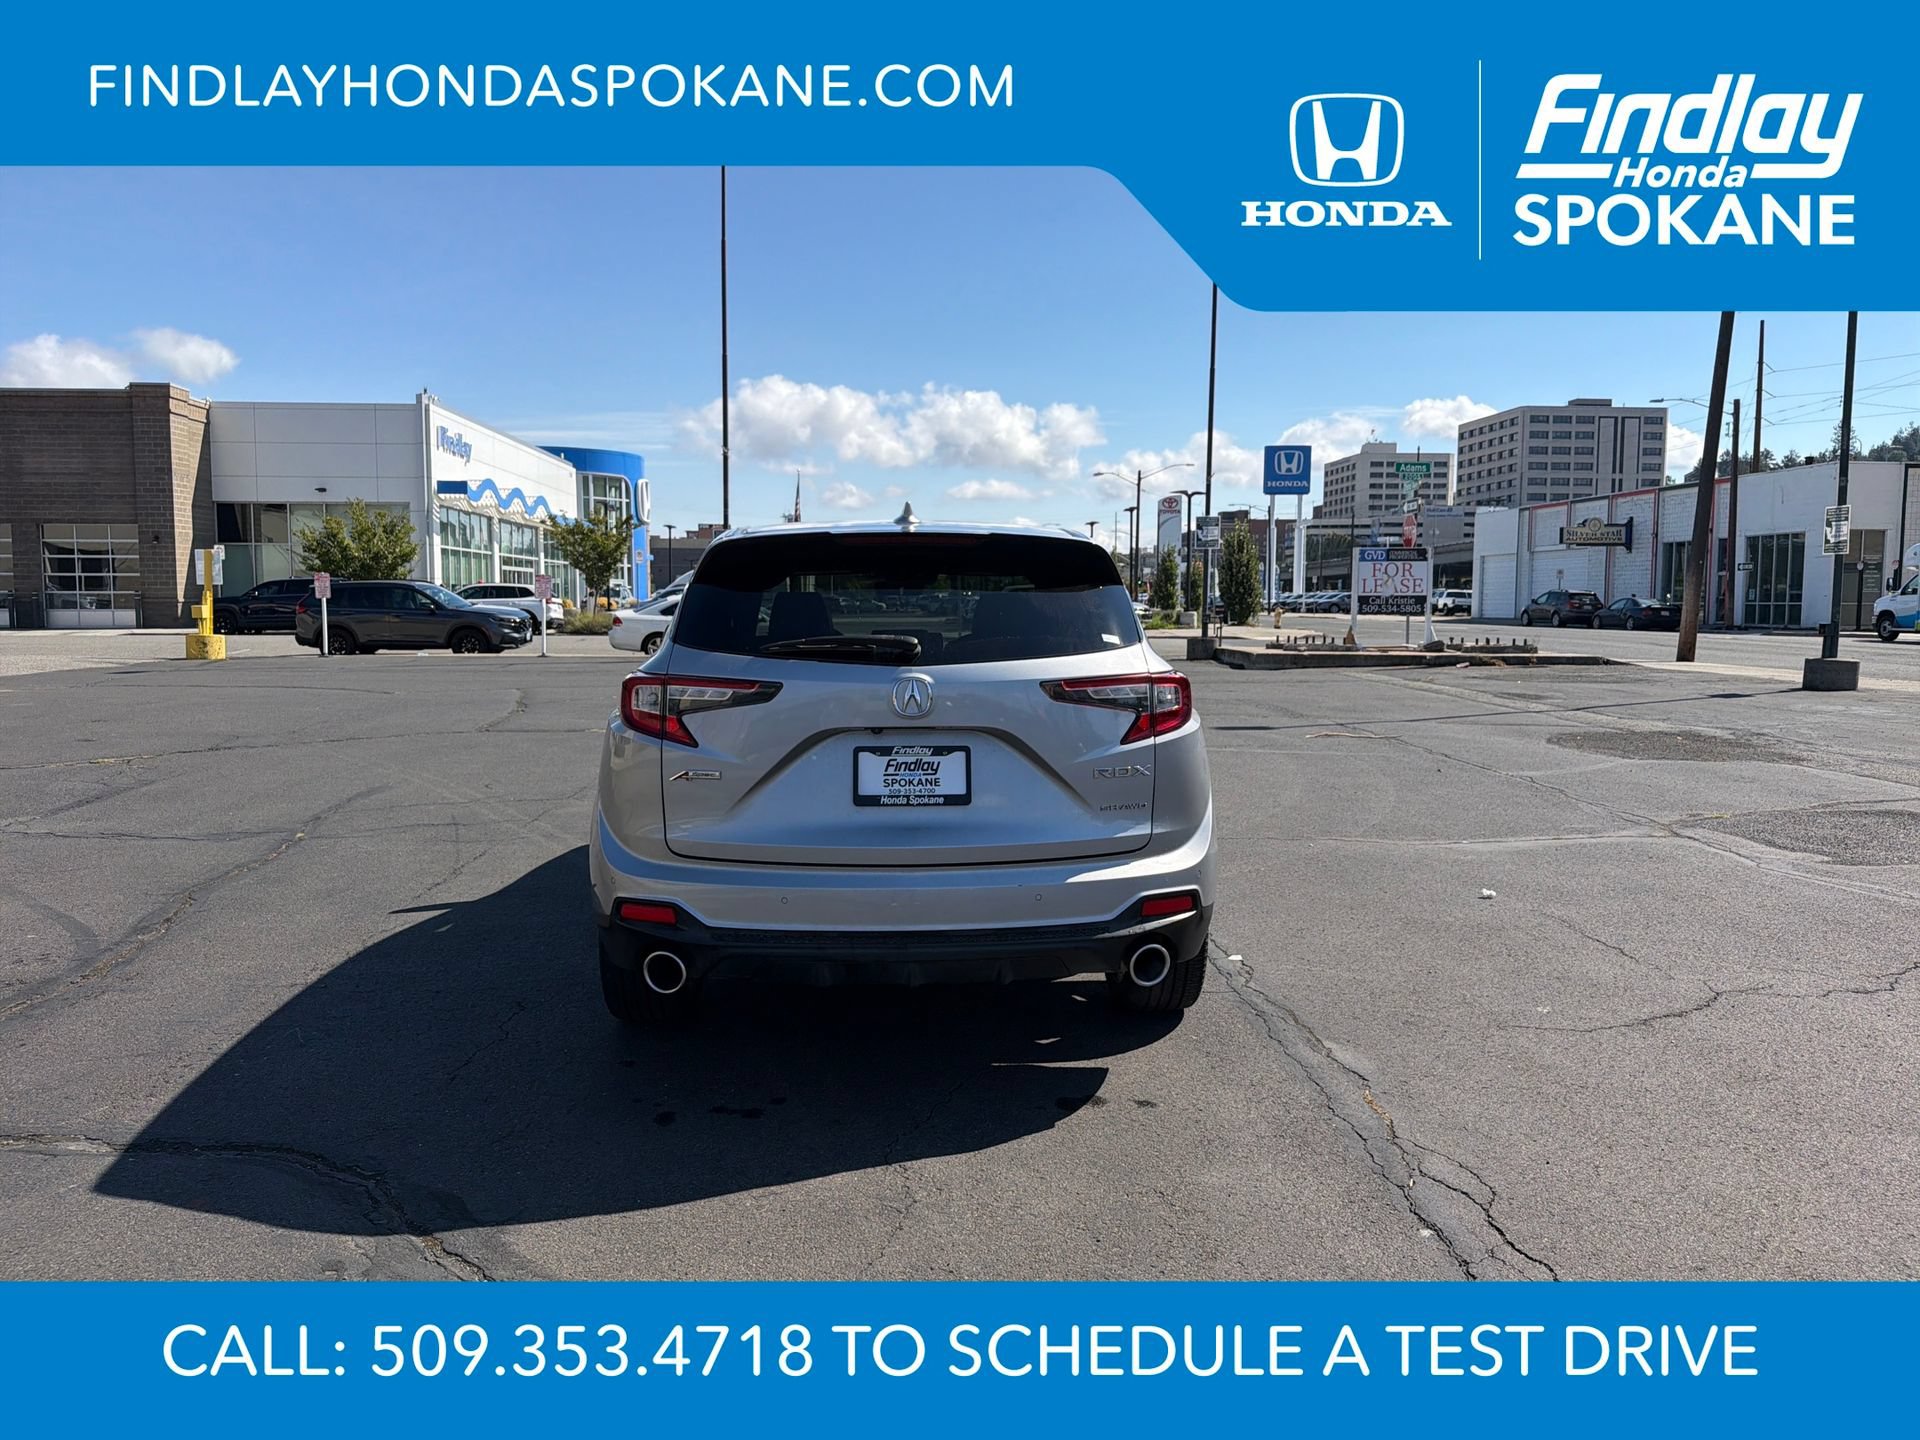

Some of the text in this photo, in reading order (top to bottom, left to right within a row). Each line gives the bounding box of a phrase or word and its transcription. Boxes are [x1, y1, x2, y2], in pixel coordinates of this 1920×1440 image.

[1400, 464, 1427, 472] Adams
[1364, 550, 1386, 560] GVD
[1371, 562, 1415, 578] FOR
[1369, 596, 1416, 604] Call Kristie
[1362, 604, 1422, 612] 509-534-5805
[892, 746, 934, 756] Findlay
[883, 758, 941, 776] Findlay
[1093, 764, 1152, 780] RDX
[883, 778, 941, 788] SPOKANE
[888, 787, 936, 795] 509-353-4700
[880, 795, 945, 807] Honda Spokane
